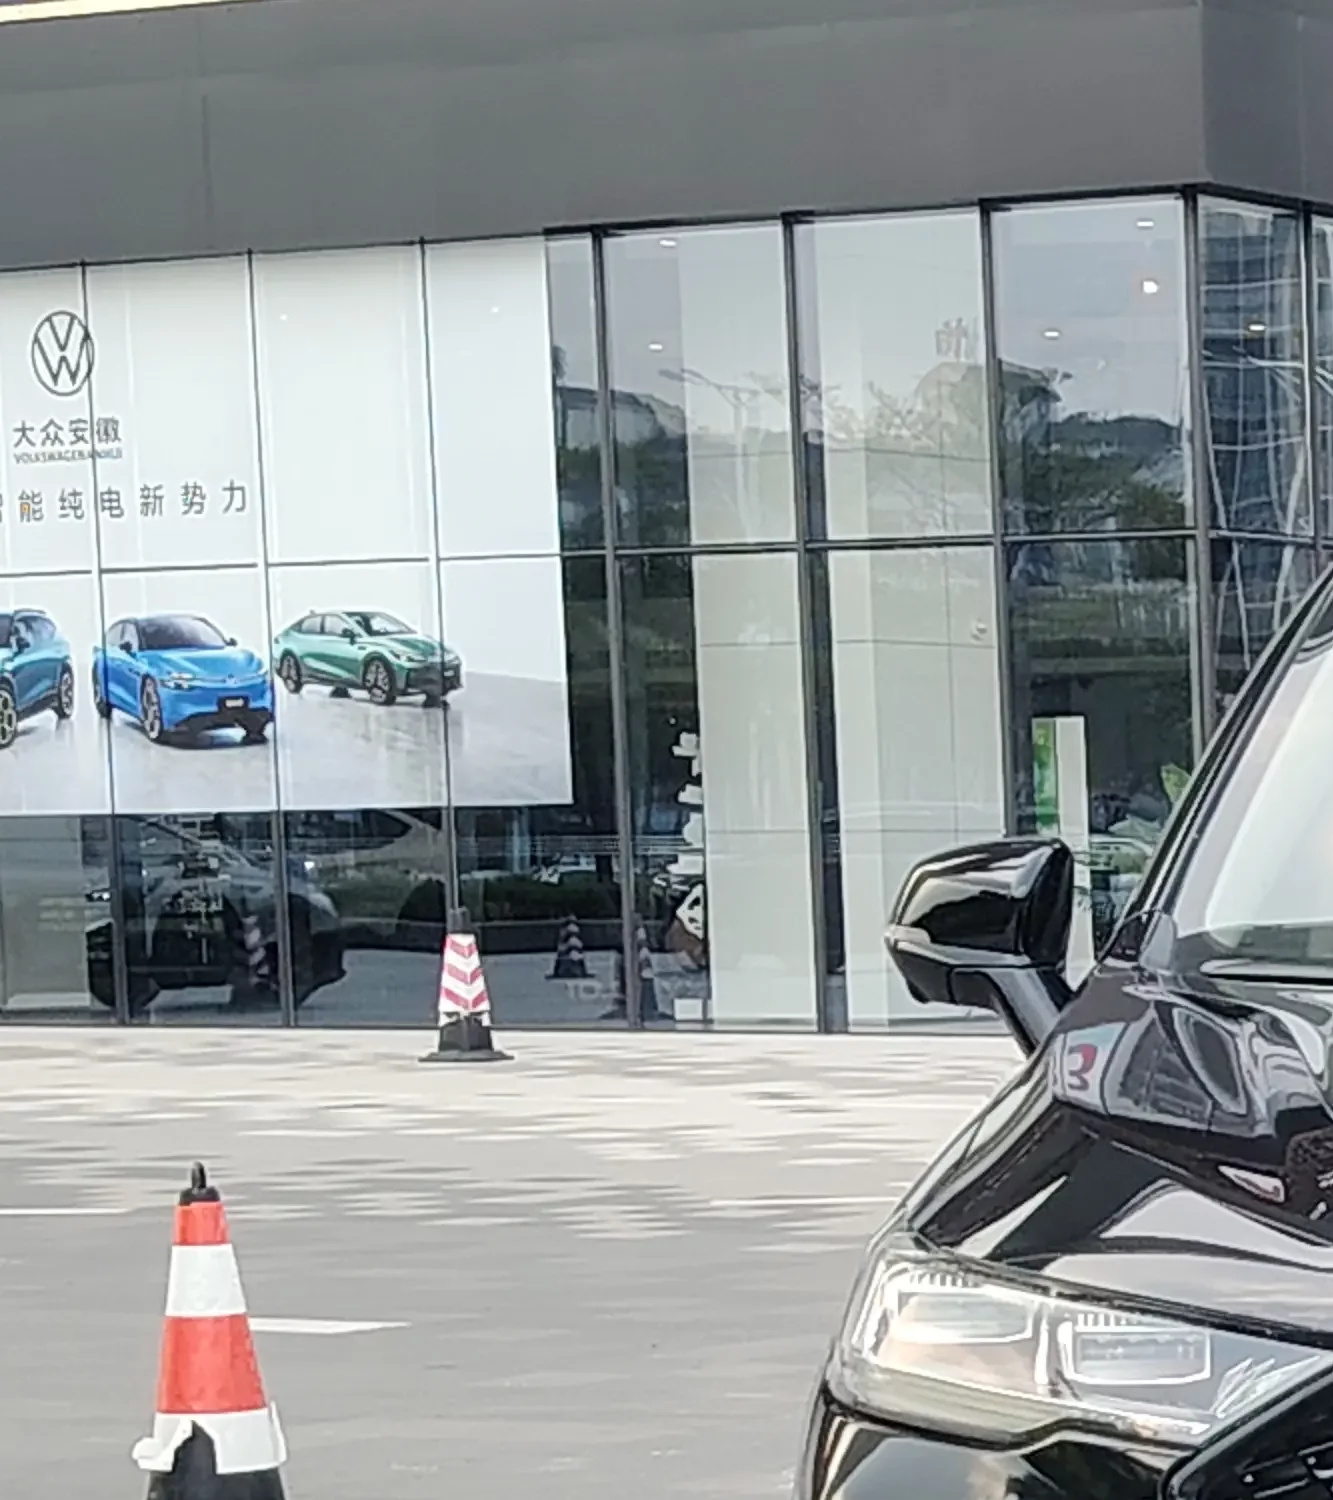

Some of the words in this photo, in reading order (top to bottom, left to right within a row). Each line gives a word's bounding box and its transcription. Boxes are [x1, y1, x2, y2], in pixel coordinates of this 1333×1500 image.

[12, 416, 122, 448] 大众安徽
[0, 478, 247, 523] 能纯电新势力
